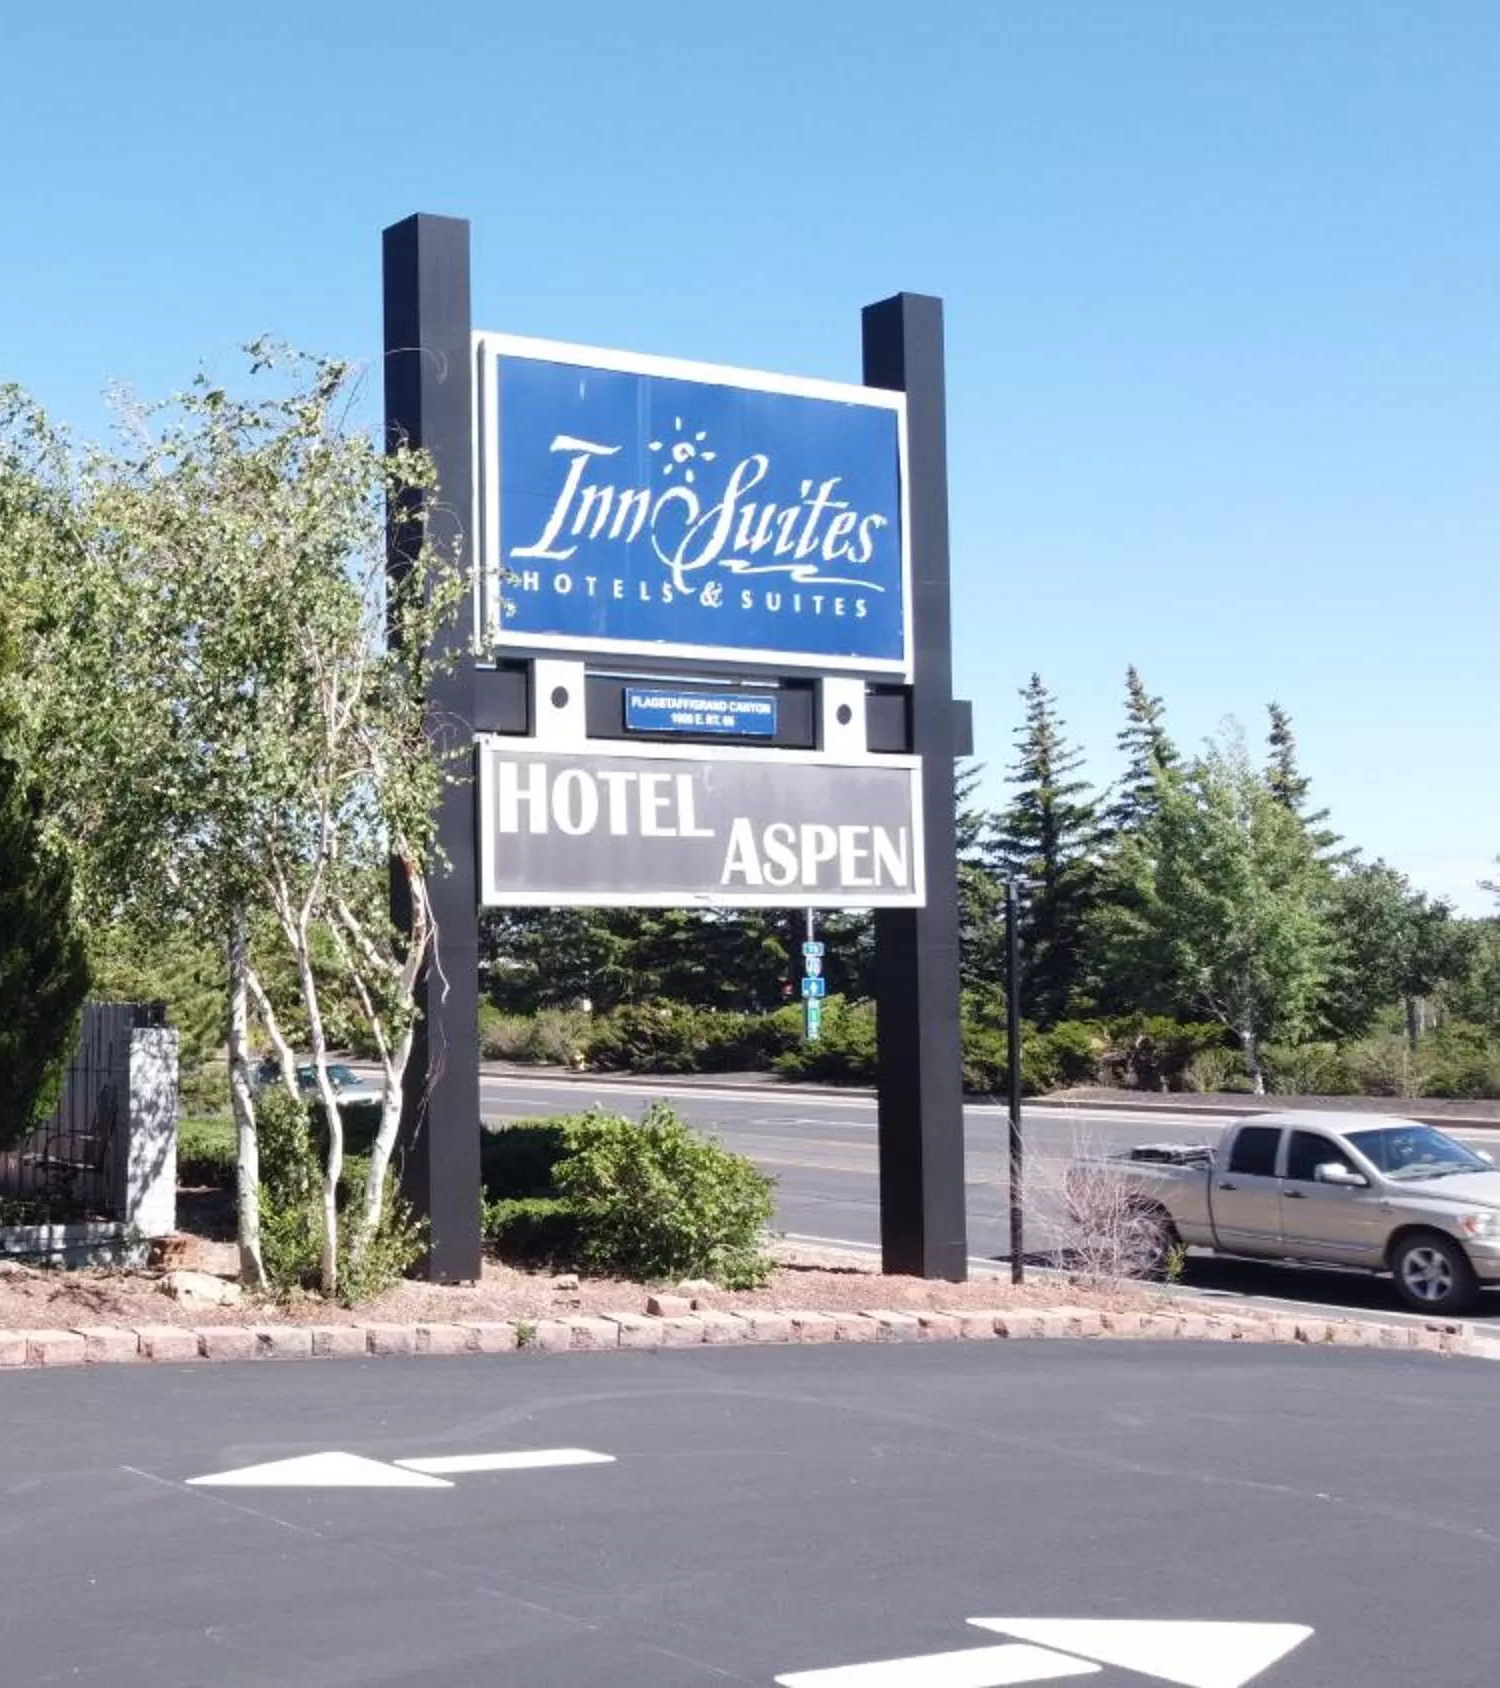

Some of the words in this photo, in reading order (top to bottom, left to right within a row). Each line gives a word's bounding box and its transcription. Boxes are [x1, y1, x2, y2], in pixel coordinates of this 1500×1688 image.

[522, 570, 674, 604] HOTELS
[700, 581, 723, 608] &
[741, 589, 867, 618] SUITES
[729, 701, 772, 714] CANYON
[499, 761, 716, 838] HOTEL
[720, 817, 907, 887] ASPEN
